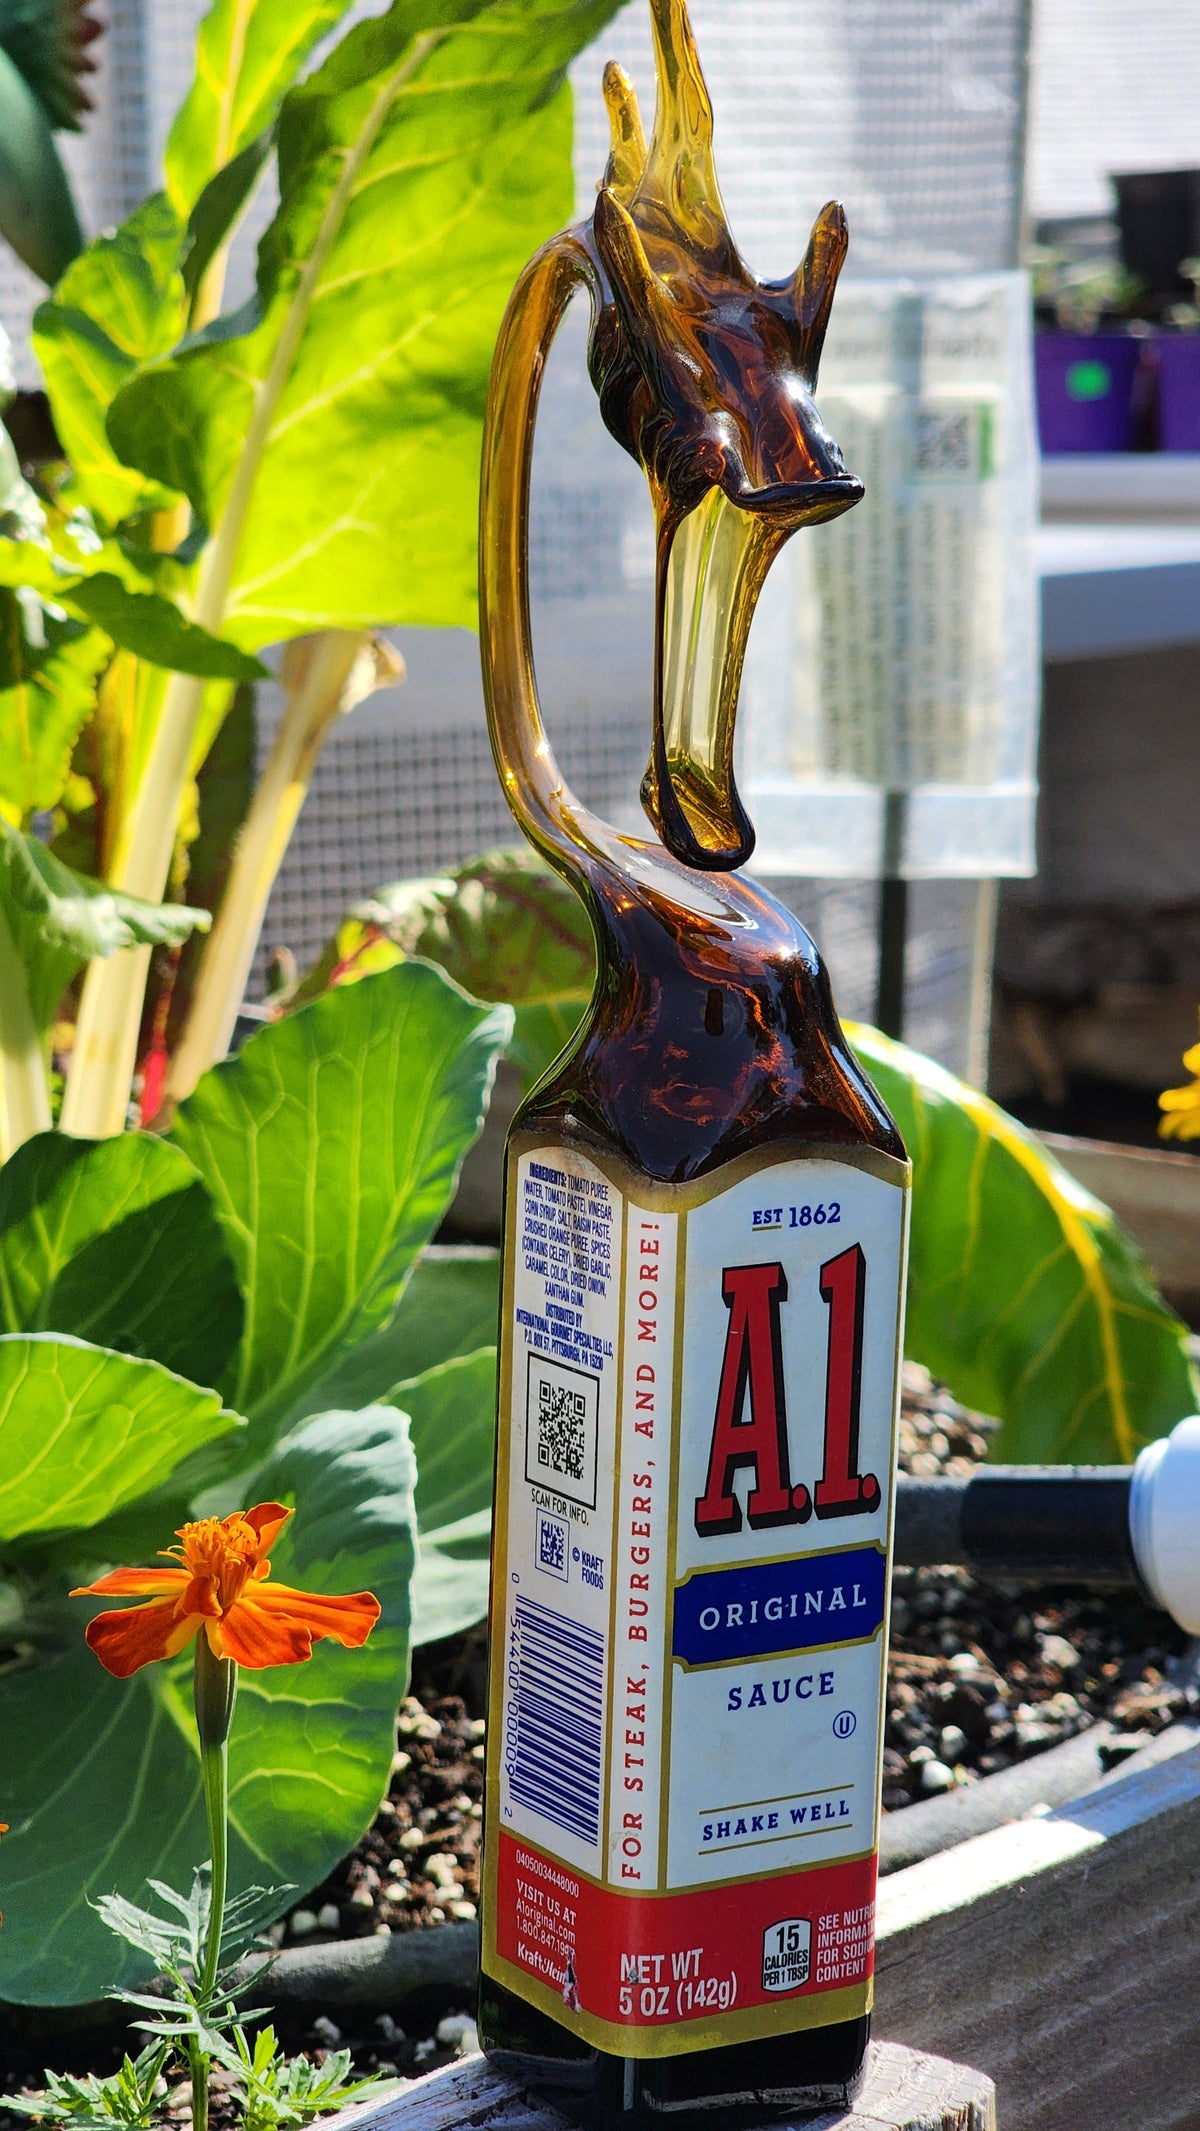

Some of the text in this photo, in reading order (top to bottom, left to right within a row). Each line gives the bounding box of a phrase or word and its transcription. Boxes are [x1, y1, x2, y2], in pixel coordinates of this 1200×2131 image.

[530, 1162, 608, 1201] INGREDIENTS: TOMATO PUREE
[524, 1179, 543, 1202] (WATER,
[545, 1186, 566, 1206] TOMATO
[588, 1200, 613, 1224] VINEGAR,
[525, 1199, 611, 1243] CORN SYRUP, SALT, RAISIN PASTE,
[752, 1202, 841, 1228] EST 1862
[522, 1235, 548, 1257] (CONTAINS
[573, 1253, 589, 1271] DRIED
[591, 1258, 611, 1280] GARLIC,
[525, 1217, 610, 1259] CRUSHED ORANGE PUREE, SPICES
[525, 1255, 606, 1299] CARAMEL COLOR, DRIED ONION,
[545, 1281, 584, 1307] XANTHAN GUM.
[516, 1308, 613, 1360] INTERNATIONAL GOURMET SPECIALTIES LLC,
[546, 1302, 582, 1328] DISTRIBUTED BY
[534, 1332, 543, 1348] BOX
[552, 1339, 581, 1366] PITTSBURGH,
[582, 1350, 588, 1365] PA
[589, 1352, 603, 1371] 15230
[531, 1488, 589, 1526] SCAN FOR INFO.
[582, 1551, 603, 1572] KRAFT
[621, 1223, 660, 1880] FOR STEAK, BURGERS, AND MORE!
[511, 1573, 520, 1583] 0
[582, 1567, 603, 1590] FOODS
[699, 1584, 867, 1630] ORIGINAL
[728, 1672, 834, 1712] SAUCE
[505, 1807, 513, 1818] 2
[703, 1800, 850, 1841] SHAKE WELL
[516, 1879, 576, 1926] VISIT US AT
[516, 1898, 575, 1944] A1original.com
[819, 1913, 839, 1931] SEE
[776, 1924, 799, 1953] 15
[817, 1937, 873, 1965] FOR SODIU
[518, 1941, 567, 1985] KraftHein
[620, 1948, 703, 1984] NET WT
[763, 1965, 808, 1987] PER 1 TBSP
[764, 1950, 808, 1970] CALORIES
[816, 1958, 865, 1982] CONTENT
[619, 1971, 738, 2016] 5 OZ (142g)
